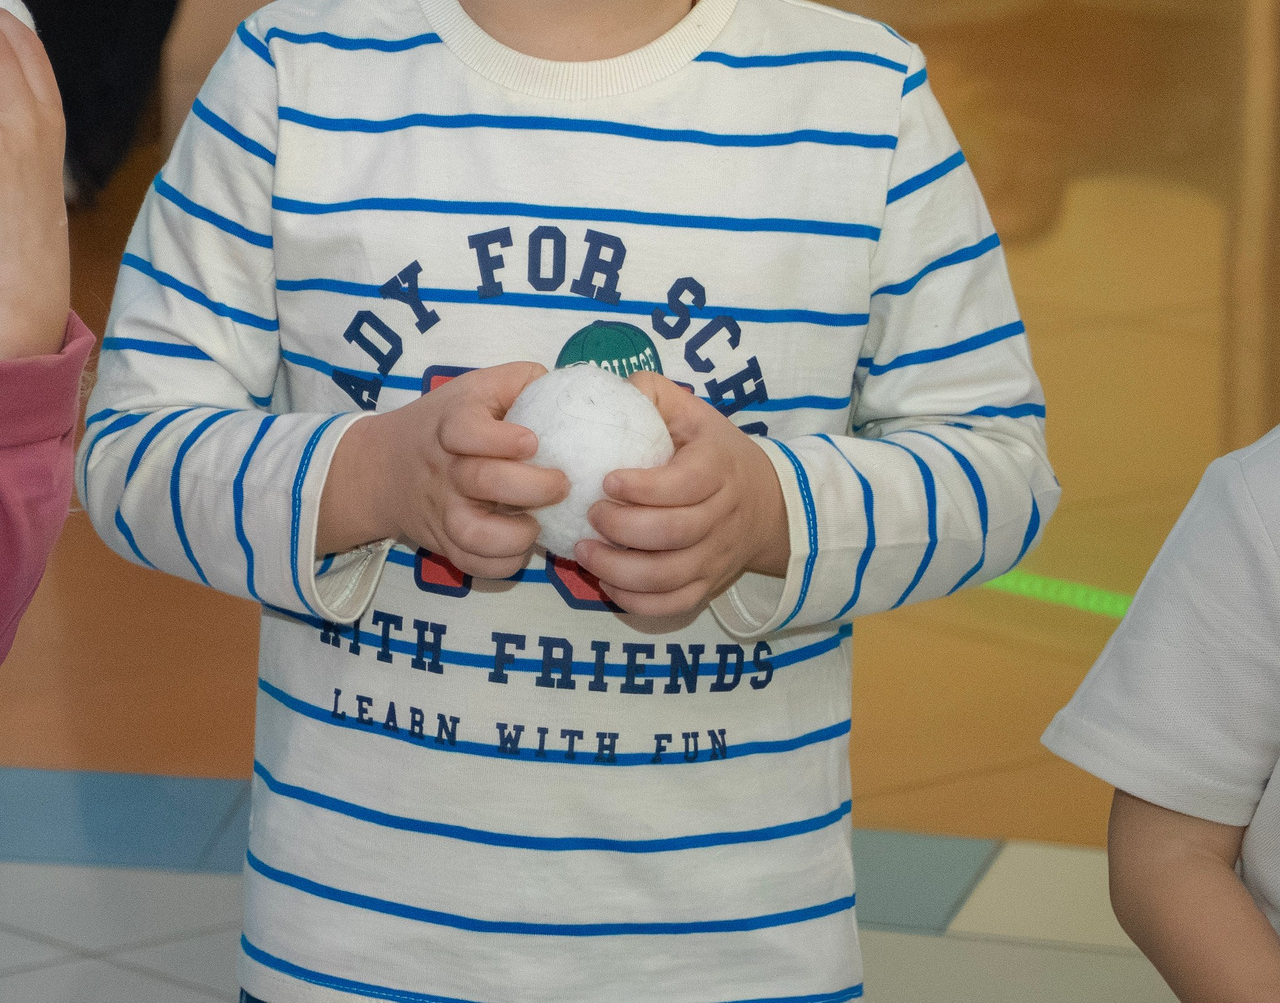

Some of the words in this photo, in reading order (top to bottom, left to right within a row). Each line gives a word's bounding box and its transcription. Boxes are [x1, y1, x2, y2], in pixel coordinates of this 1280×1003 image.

[331, 260, 441, 411] ADY
[467, 225, 627, 306] FOR
[651, 276, 769, 436] SCH
[488, 632, 774, 695] FRIENDS
[331, 688, 460, 746] LEARN
[496, 722, 620, 763] WITH
[651, 729, 728, 764] FUN
